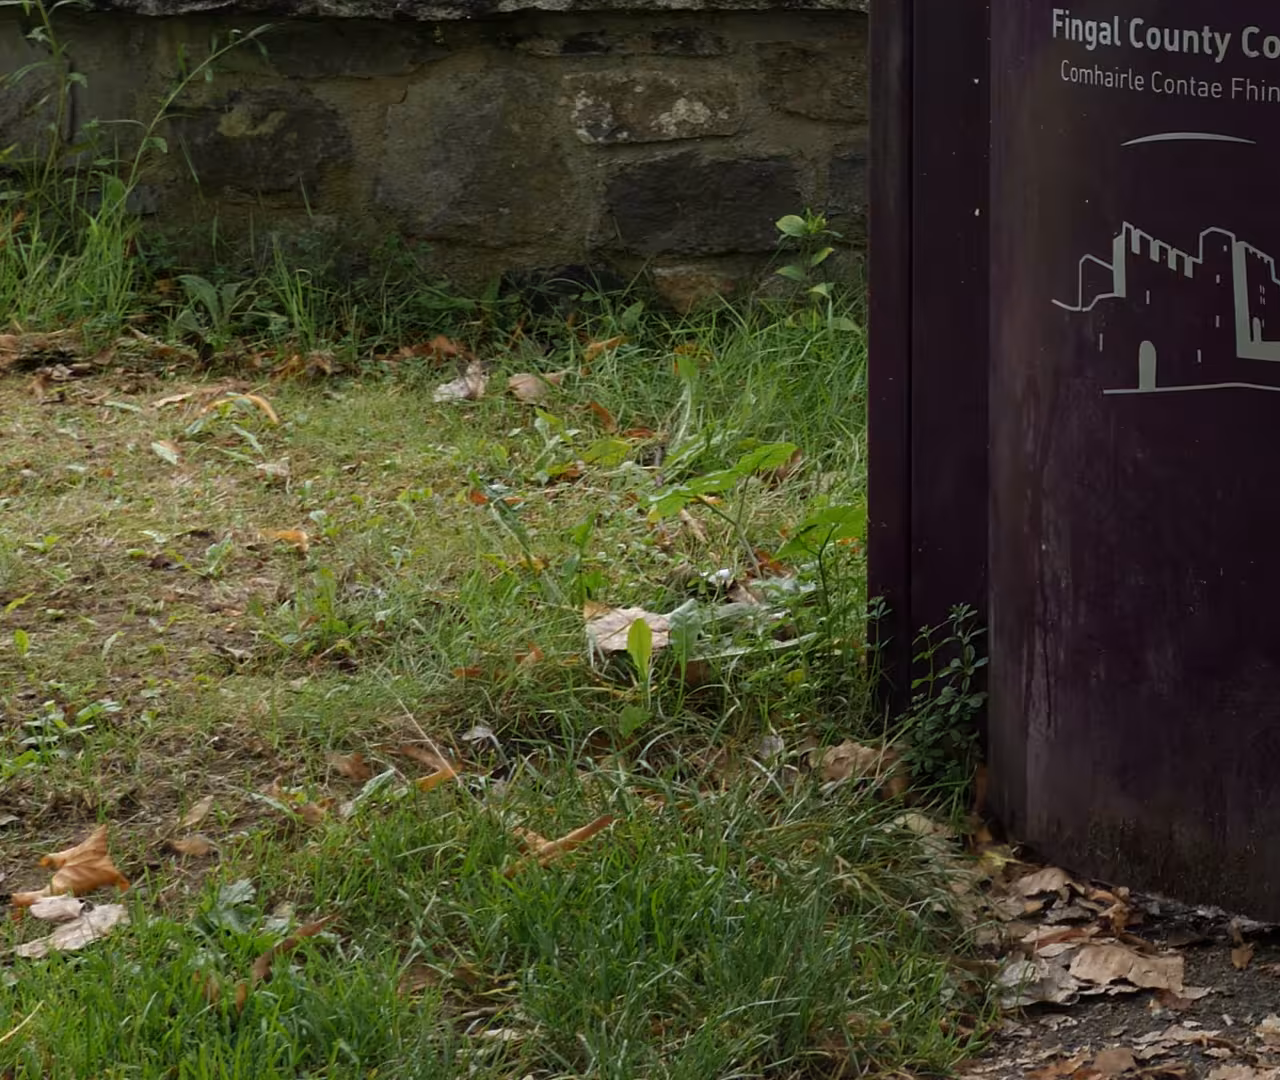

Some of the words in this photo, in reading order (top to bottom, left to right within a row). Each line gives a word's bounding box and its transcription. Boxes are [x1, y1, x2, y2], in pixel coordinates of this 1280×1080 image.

[1052, 8, 1122, 51] Fingal
[1129, 17, 1232, 63] County
[1060, 59, 1145, 91] Comhairle
[1151, 71, 1223, 98] Contae
